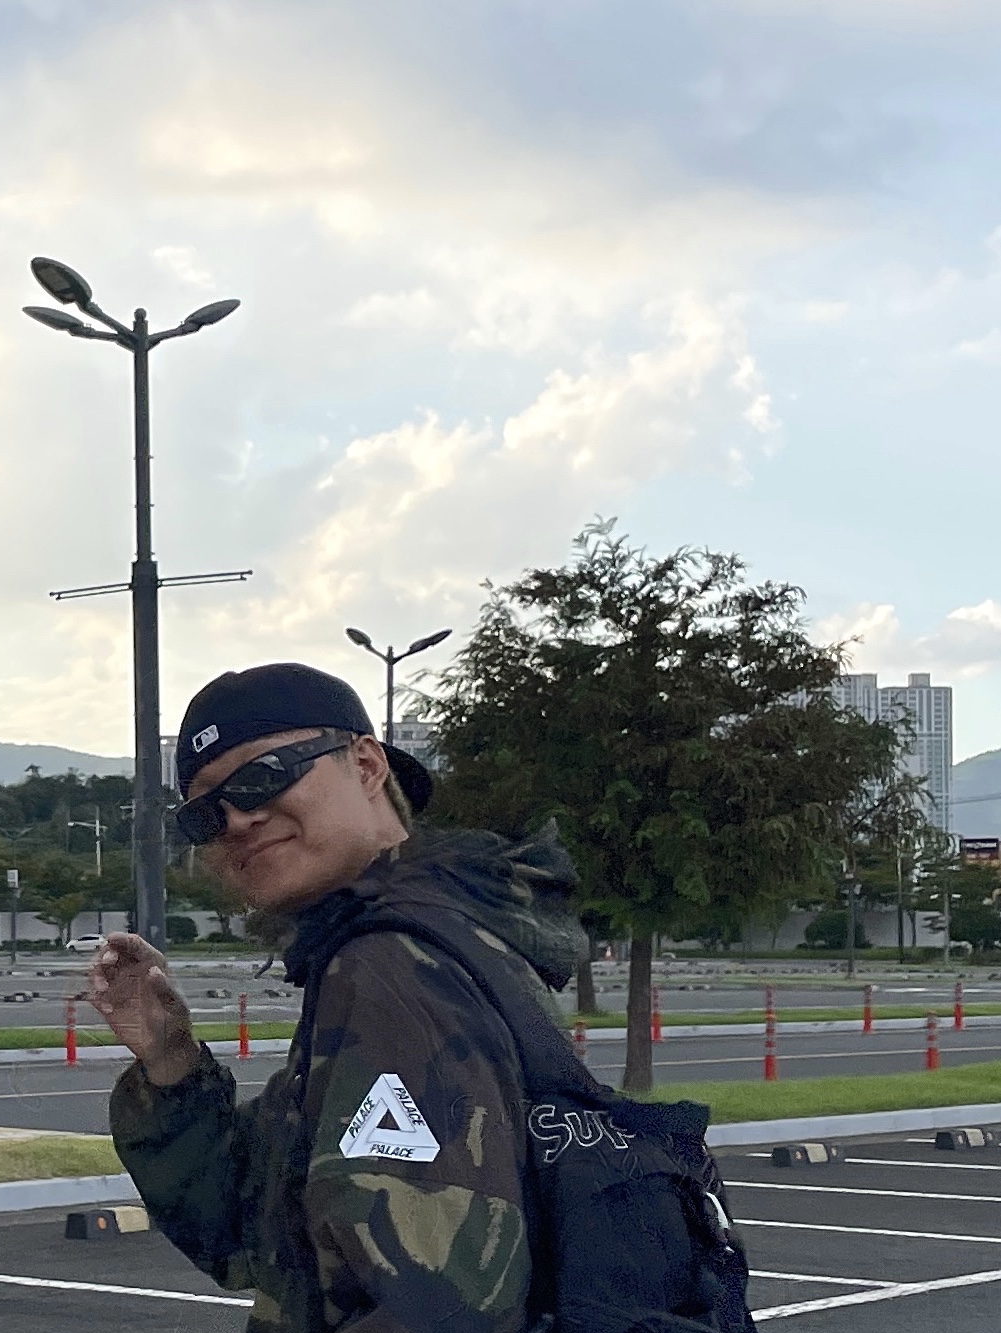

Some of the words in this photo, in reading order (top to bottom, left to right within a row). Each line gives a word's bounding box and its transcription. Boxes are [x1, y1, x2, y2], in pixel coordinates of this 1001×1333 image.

[348, 1096, 375, 1138] PALACE
[393, 1087, 425, 1126] PALACE
[369, 1143, 416, 1158] PALACE
